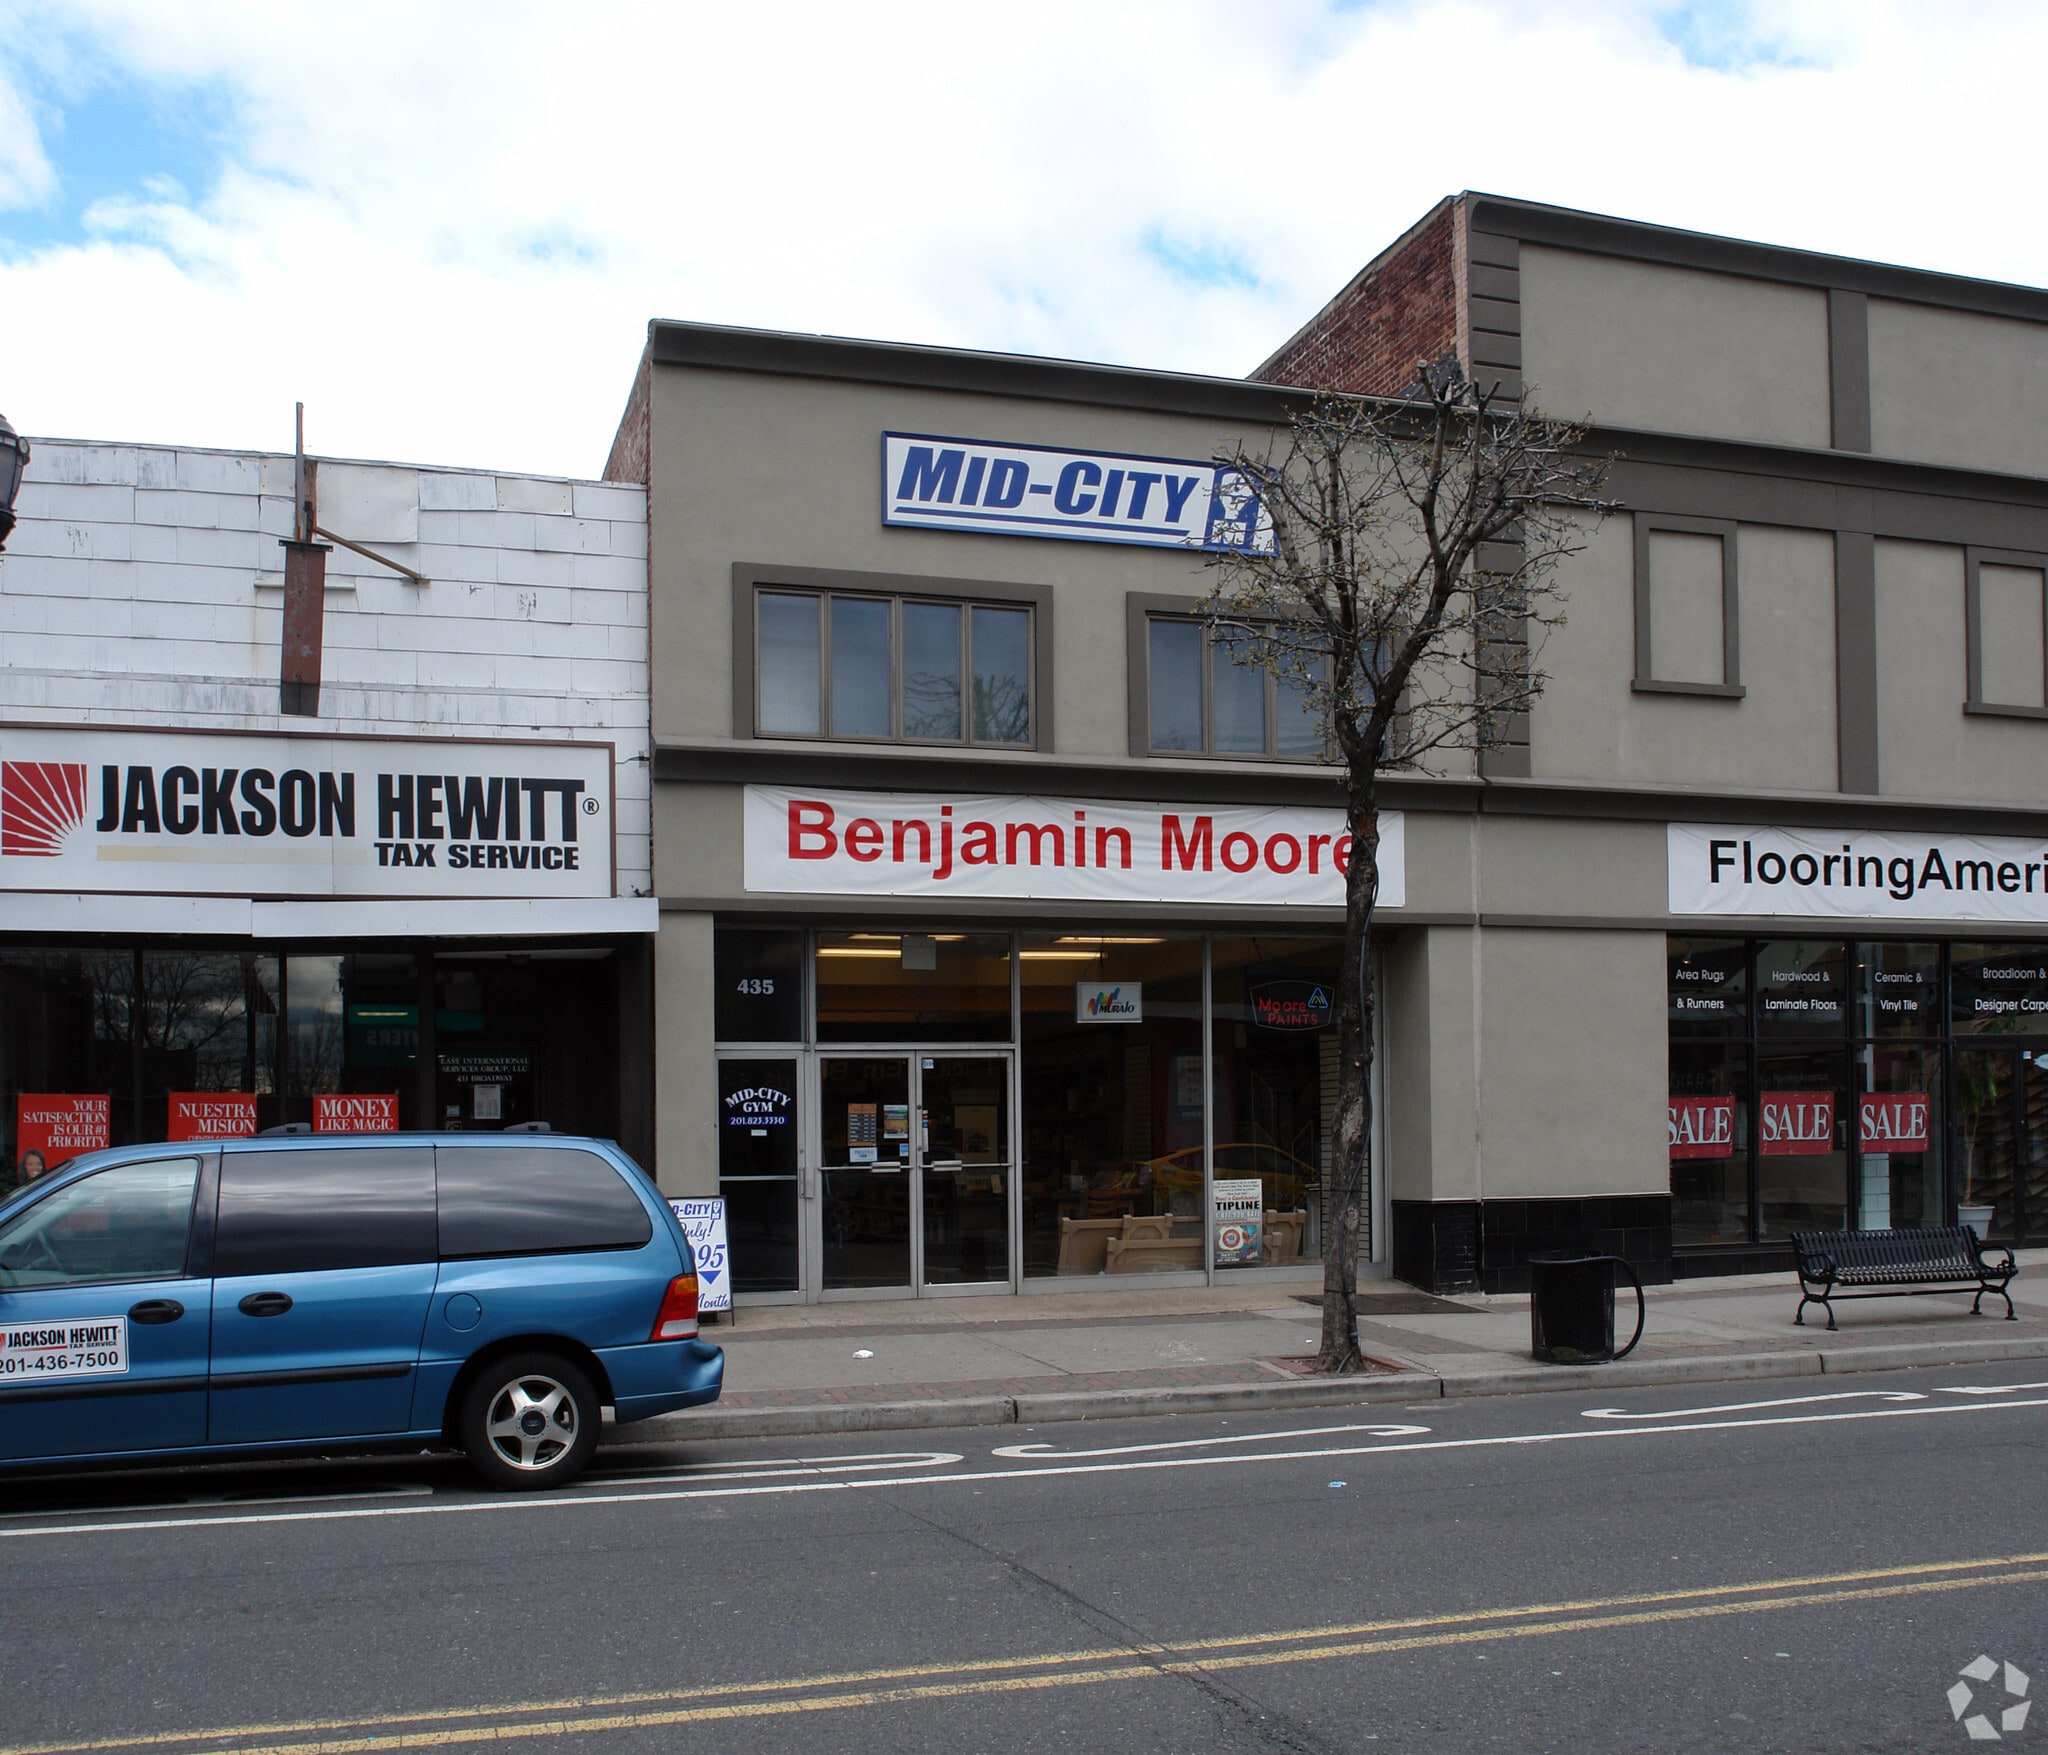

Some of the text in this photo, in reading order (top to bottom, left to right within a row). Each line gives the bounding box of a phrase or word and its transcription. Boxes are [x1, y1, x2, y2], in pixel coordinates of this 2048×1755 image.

[896, 446, 1200, 523] MID-CITY
[97, 765, 355, 837] JACKSON
[787, 800, 1132, 880] Benjamin
[374, 843, 579, 870] TAX SERVICE
[1676, 969, 1724, 983] Area Rugs
[1772, 971, 1830, 982] Hardwood &
[1875, 972, 1923, 983] Ceramic &
[1983, 968, 2046, 979] Broadloom &
[737, 979, 774, 994] 435
[1677, 998, 1724, 1009] & Runners
[1766, 999, 1837, 1010] Laminate Floors
[1880, 1000, 1918, 1012] Vinyl Tile
[1975, 999, 2018, 1013] Designer
[1268, 1014, 1318, 1026] PAINTS
[464, 1057, 529, 1065] INTERNATIONAL
[442, 1065, 479, 1073] SERVICES
[725, 1087, 792, 1108] MID-CITY
[73, 1100, 107, 1111] YOUR
[178, 1103, 257, 1118] NUESTRA
[319, 1099, 394, 1118] MONEY
[743, 1101, 773, 1112] GYM
[23, 1111, 107, 1123] SATISFACTION
[730, 1116, 785, 1125] 201.823.3330
[1762, 1103, 1831, 1142] SALE
[1861, 1103, 1927, 1141] SALE
[54, 1124, 107, 1135] IS OUR #1
[197, 1119, 255, 1133] MISION
[319, 1119, 394, 1131] LIKE MAGIC
[47, 1136, 109, 1148] PRIORITY.
[1215, 1200, 1260, 1211] TIPLINE
[8, 1326, 118, 1348] JACKSON HEWITT
